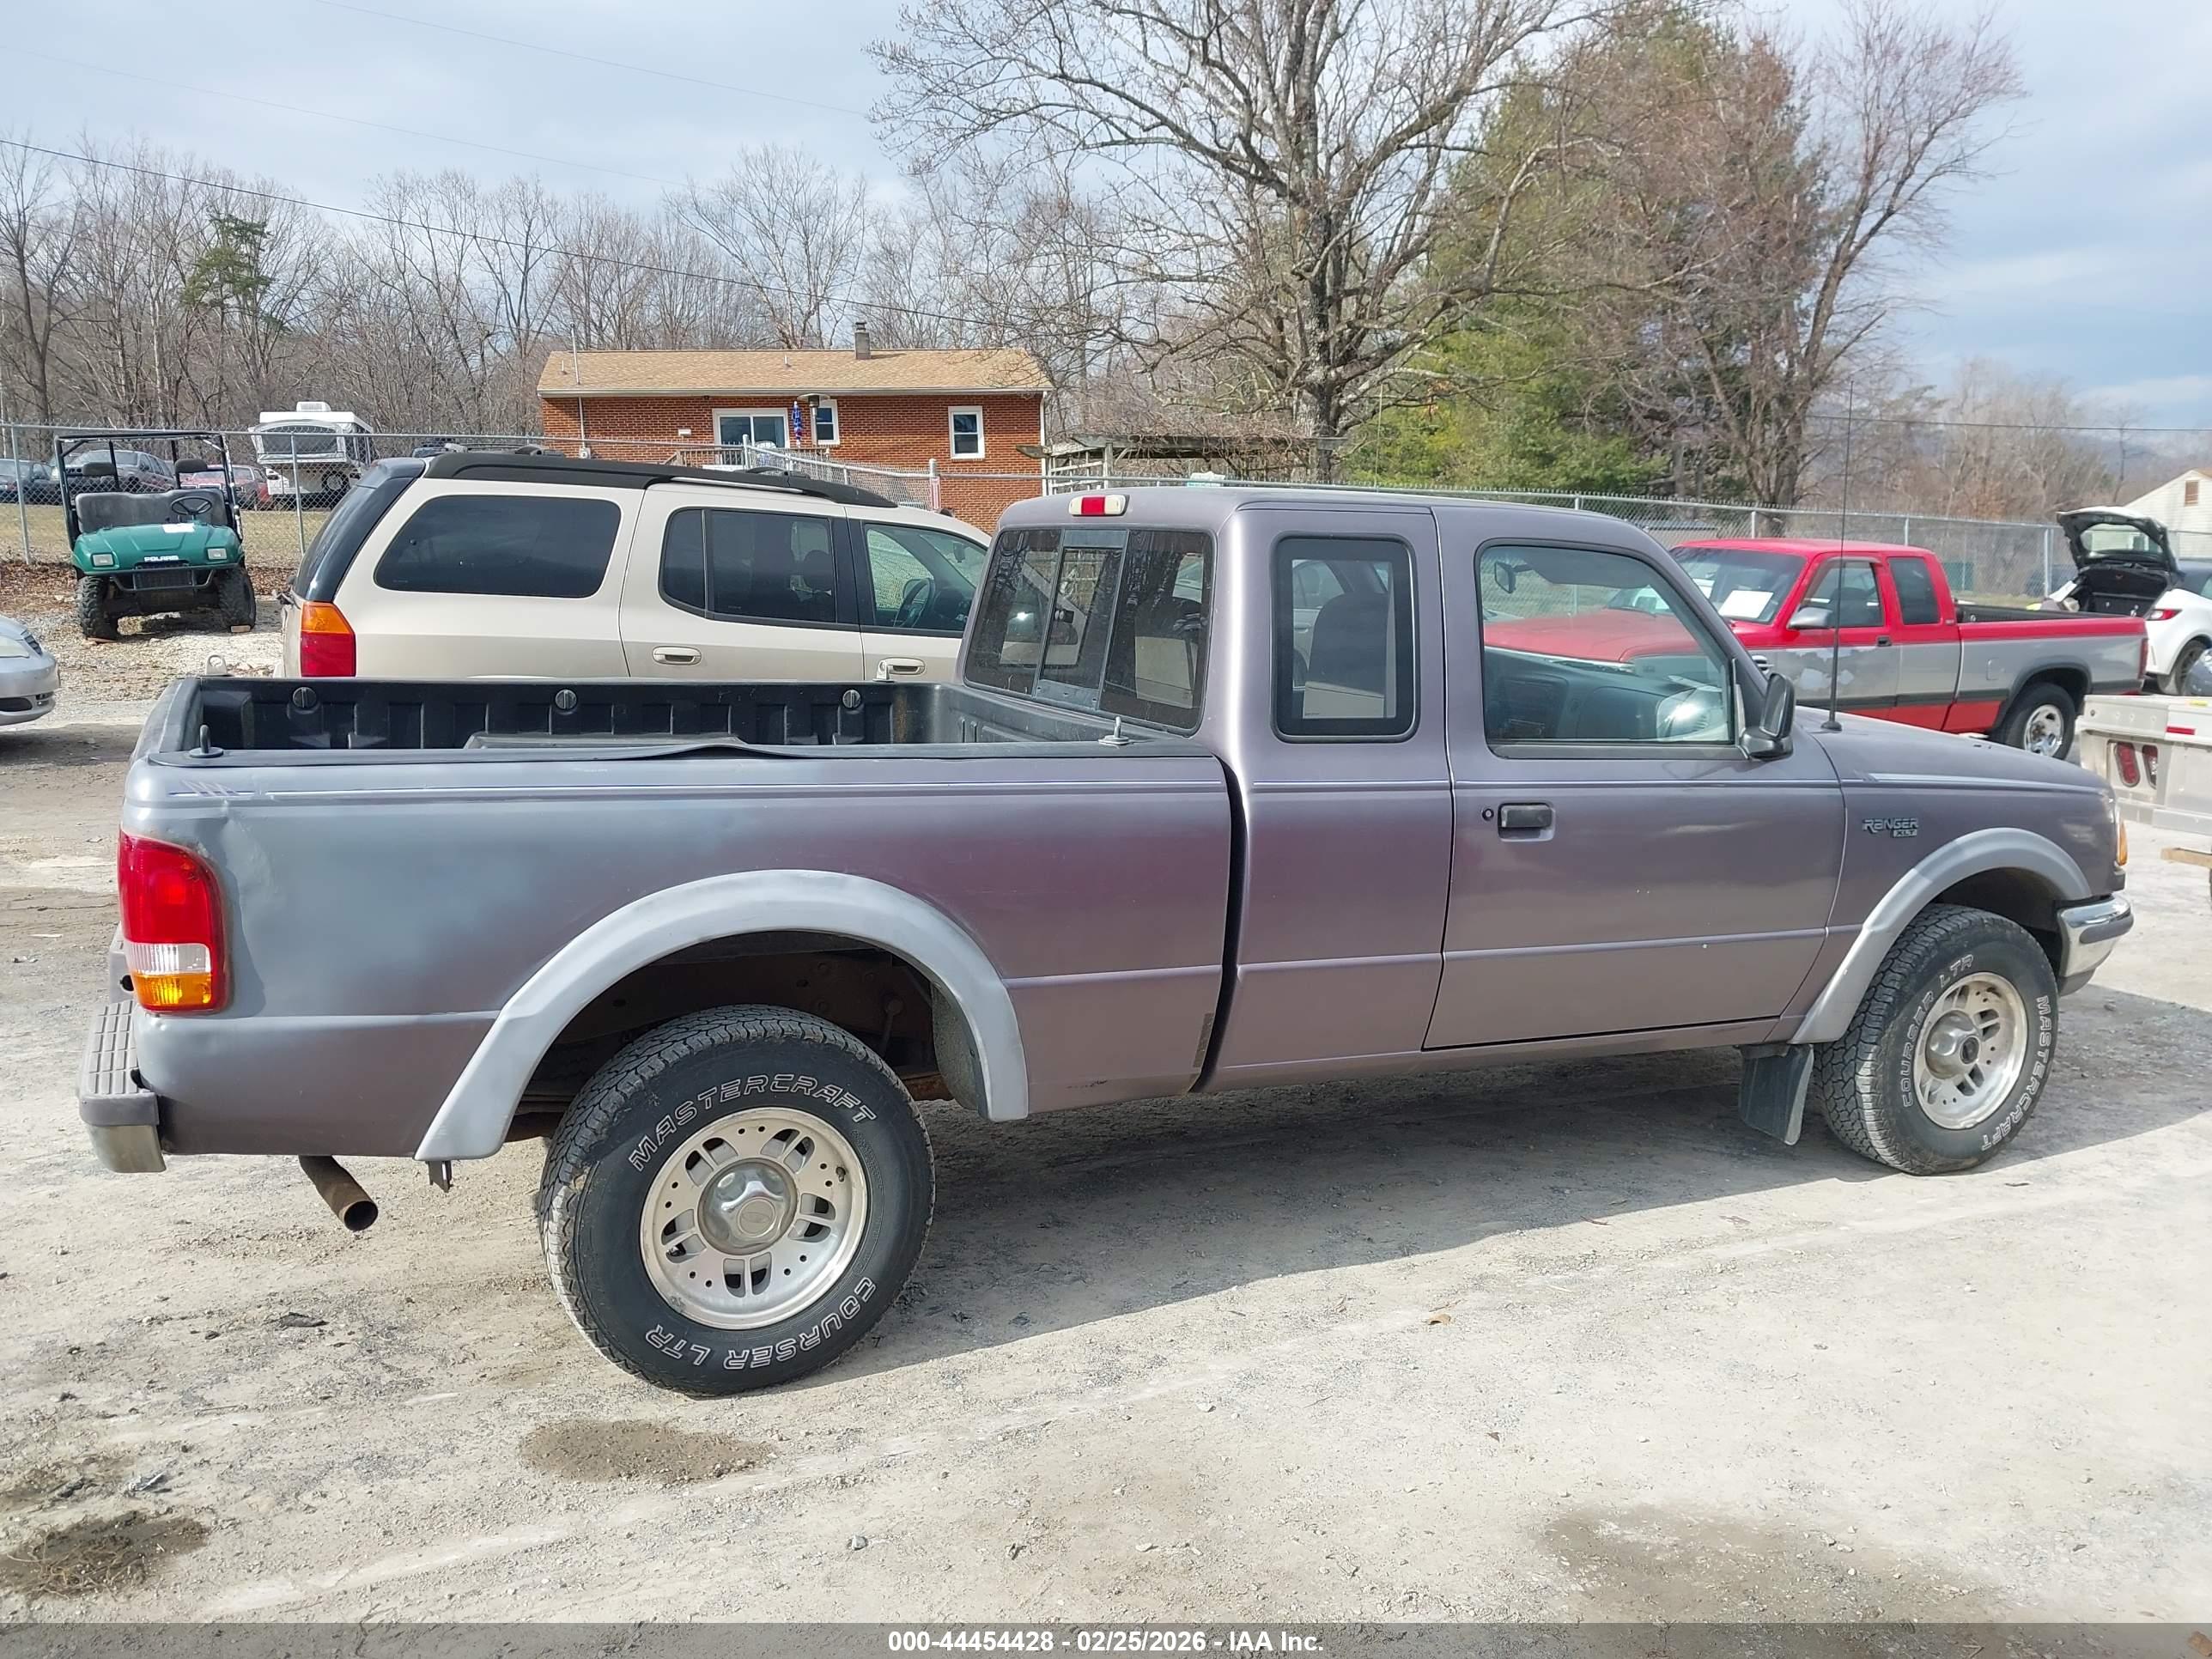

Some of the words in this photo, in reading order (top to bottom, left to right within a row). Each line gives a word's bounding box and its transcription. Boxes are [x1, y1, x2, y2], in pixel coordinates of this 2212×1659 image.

[1862, 817, 1918, 833] RANGER
[1899, 991, 1935, 1108] COURSER
[1939, 953, 1974, 988] LTR
[1981, 995, 2051, 1152] MASTERCRAFT
[628, 1073, 878, 1171] MASTERCRAFT
[644, 1323, 713, 1367] LTR
[723, 1276, 878, 1370] COURSER
